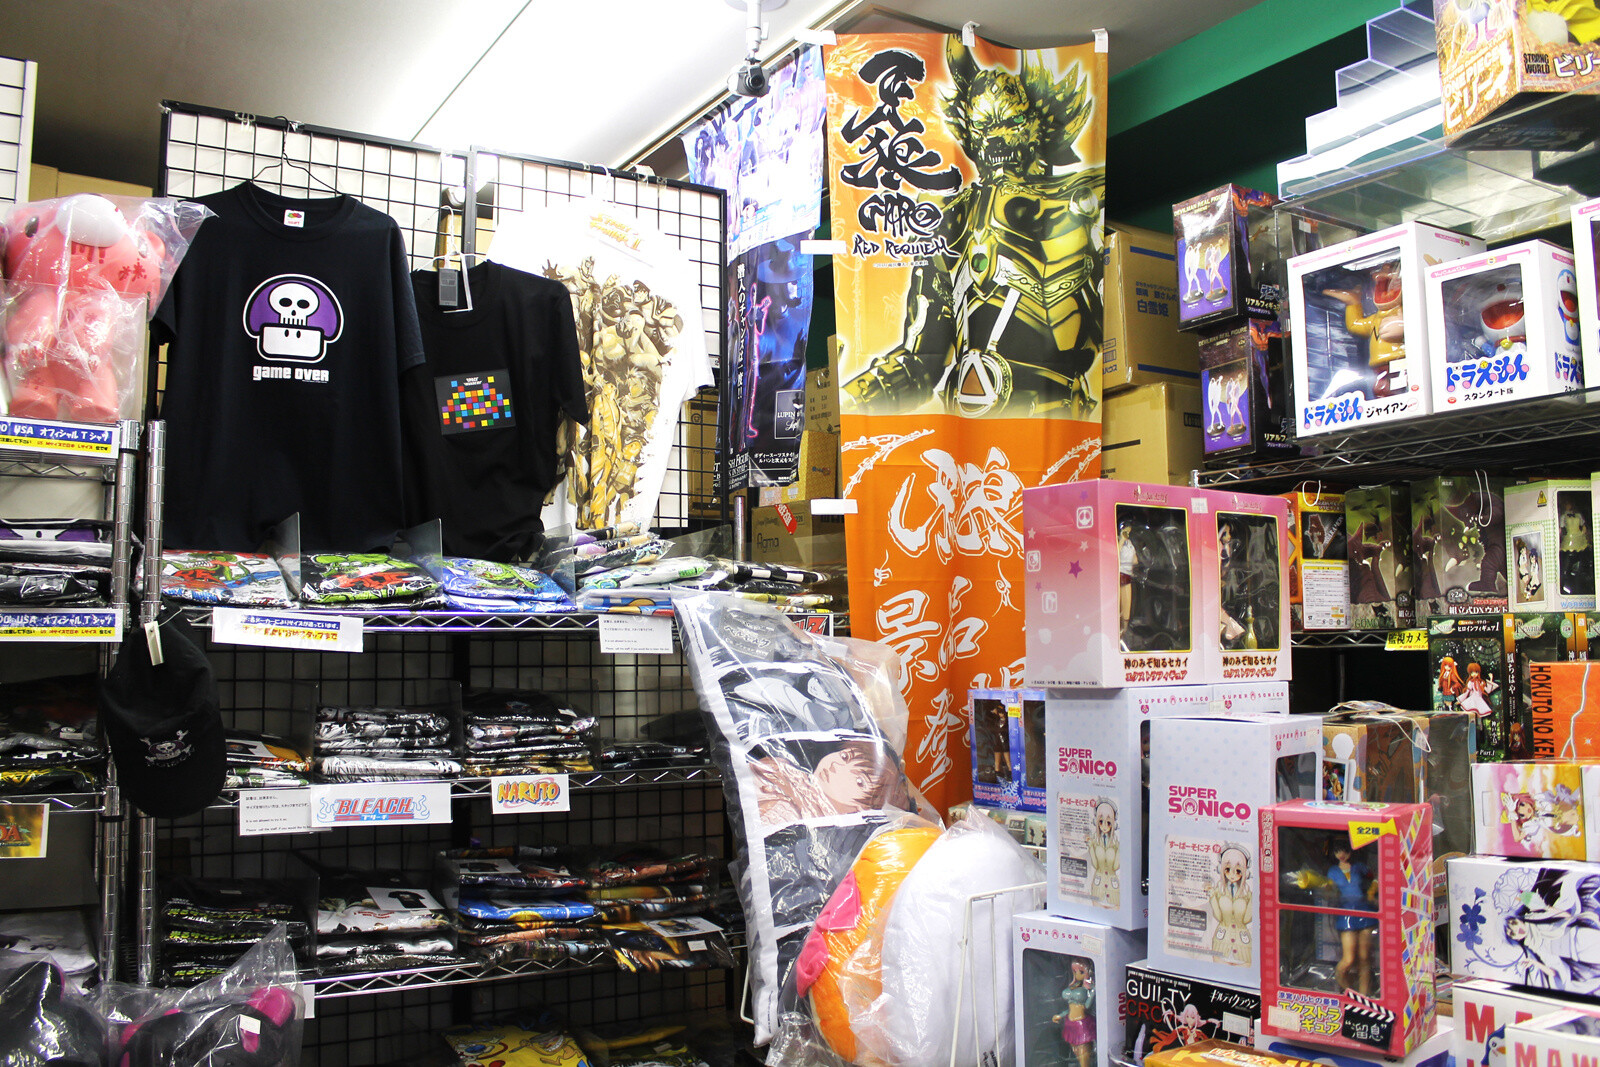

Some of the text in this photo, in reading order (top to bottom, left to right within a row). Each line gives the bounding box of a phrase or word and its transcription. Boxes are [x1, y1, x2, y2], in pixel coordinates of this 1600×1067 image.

[1525, 63, 1551, 74] WORLD
[853, 233, 962, 261] RED REQUIEM
[253, 365, 292, 381] game
[1446, 353, 1530, 393] ドラえもん
[1365, 401, 1409, 419] ジャイアン
[1124, 657, 1188, 669] 神のみぞ知るセカイ
[1223, 655, 1277, 667] 神のみぞ知るセカイ
[1530, 665, 1553, 714] HOKUTO
[1138, 697, 1168, 705] SUPER
[1532, 717, 1554, 734] NO
[1059, 747, 1092, 759] SUPER
[1059, 758, 1117, 777] SONICO
[497, 781, 560, 804] NARUTO
[1169, 785, 1217, 799] SUPER
[336, 799, 413, 815] BLEACH
[1168, 797, 1251, 820] SONICO
[1356, 826, 1380, 836] 全2種
[1019, 926, 1049, 936] SUPER
